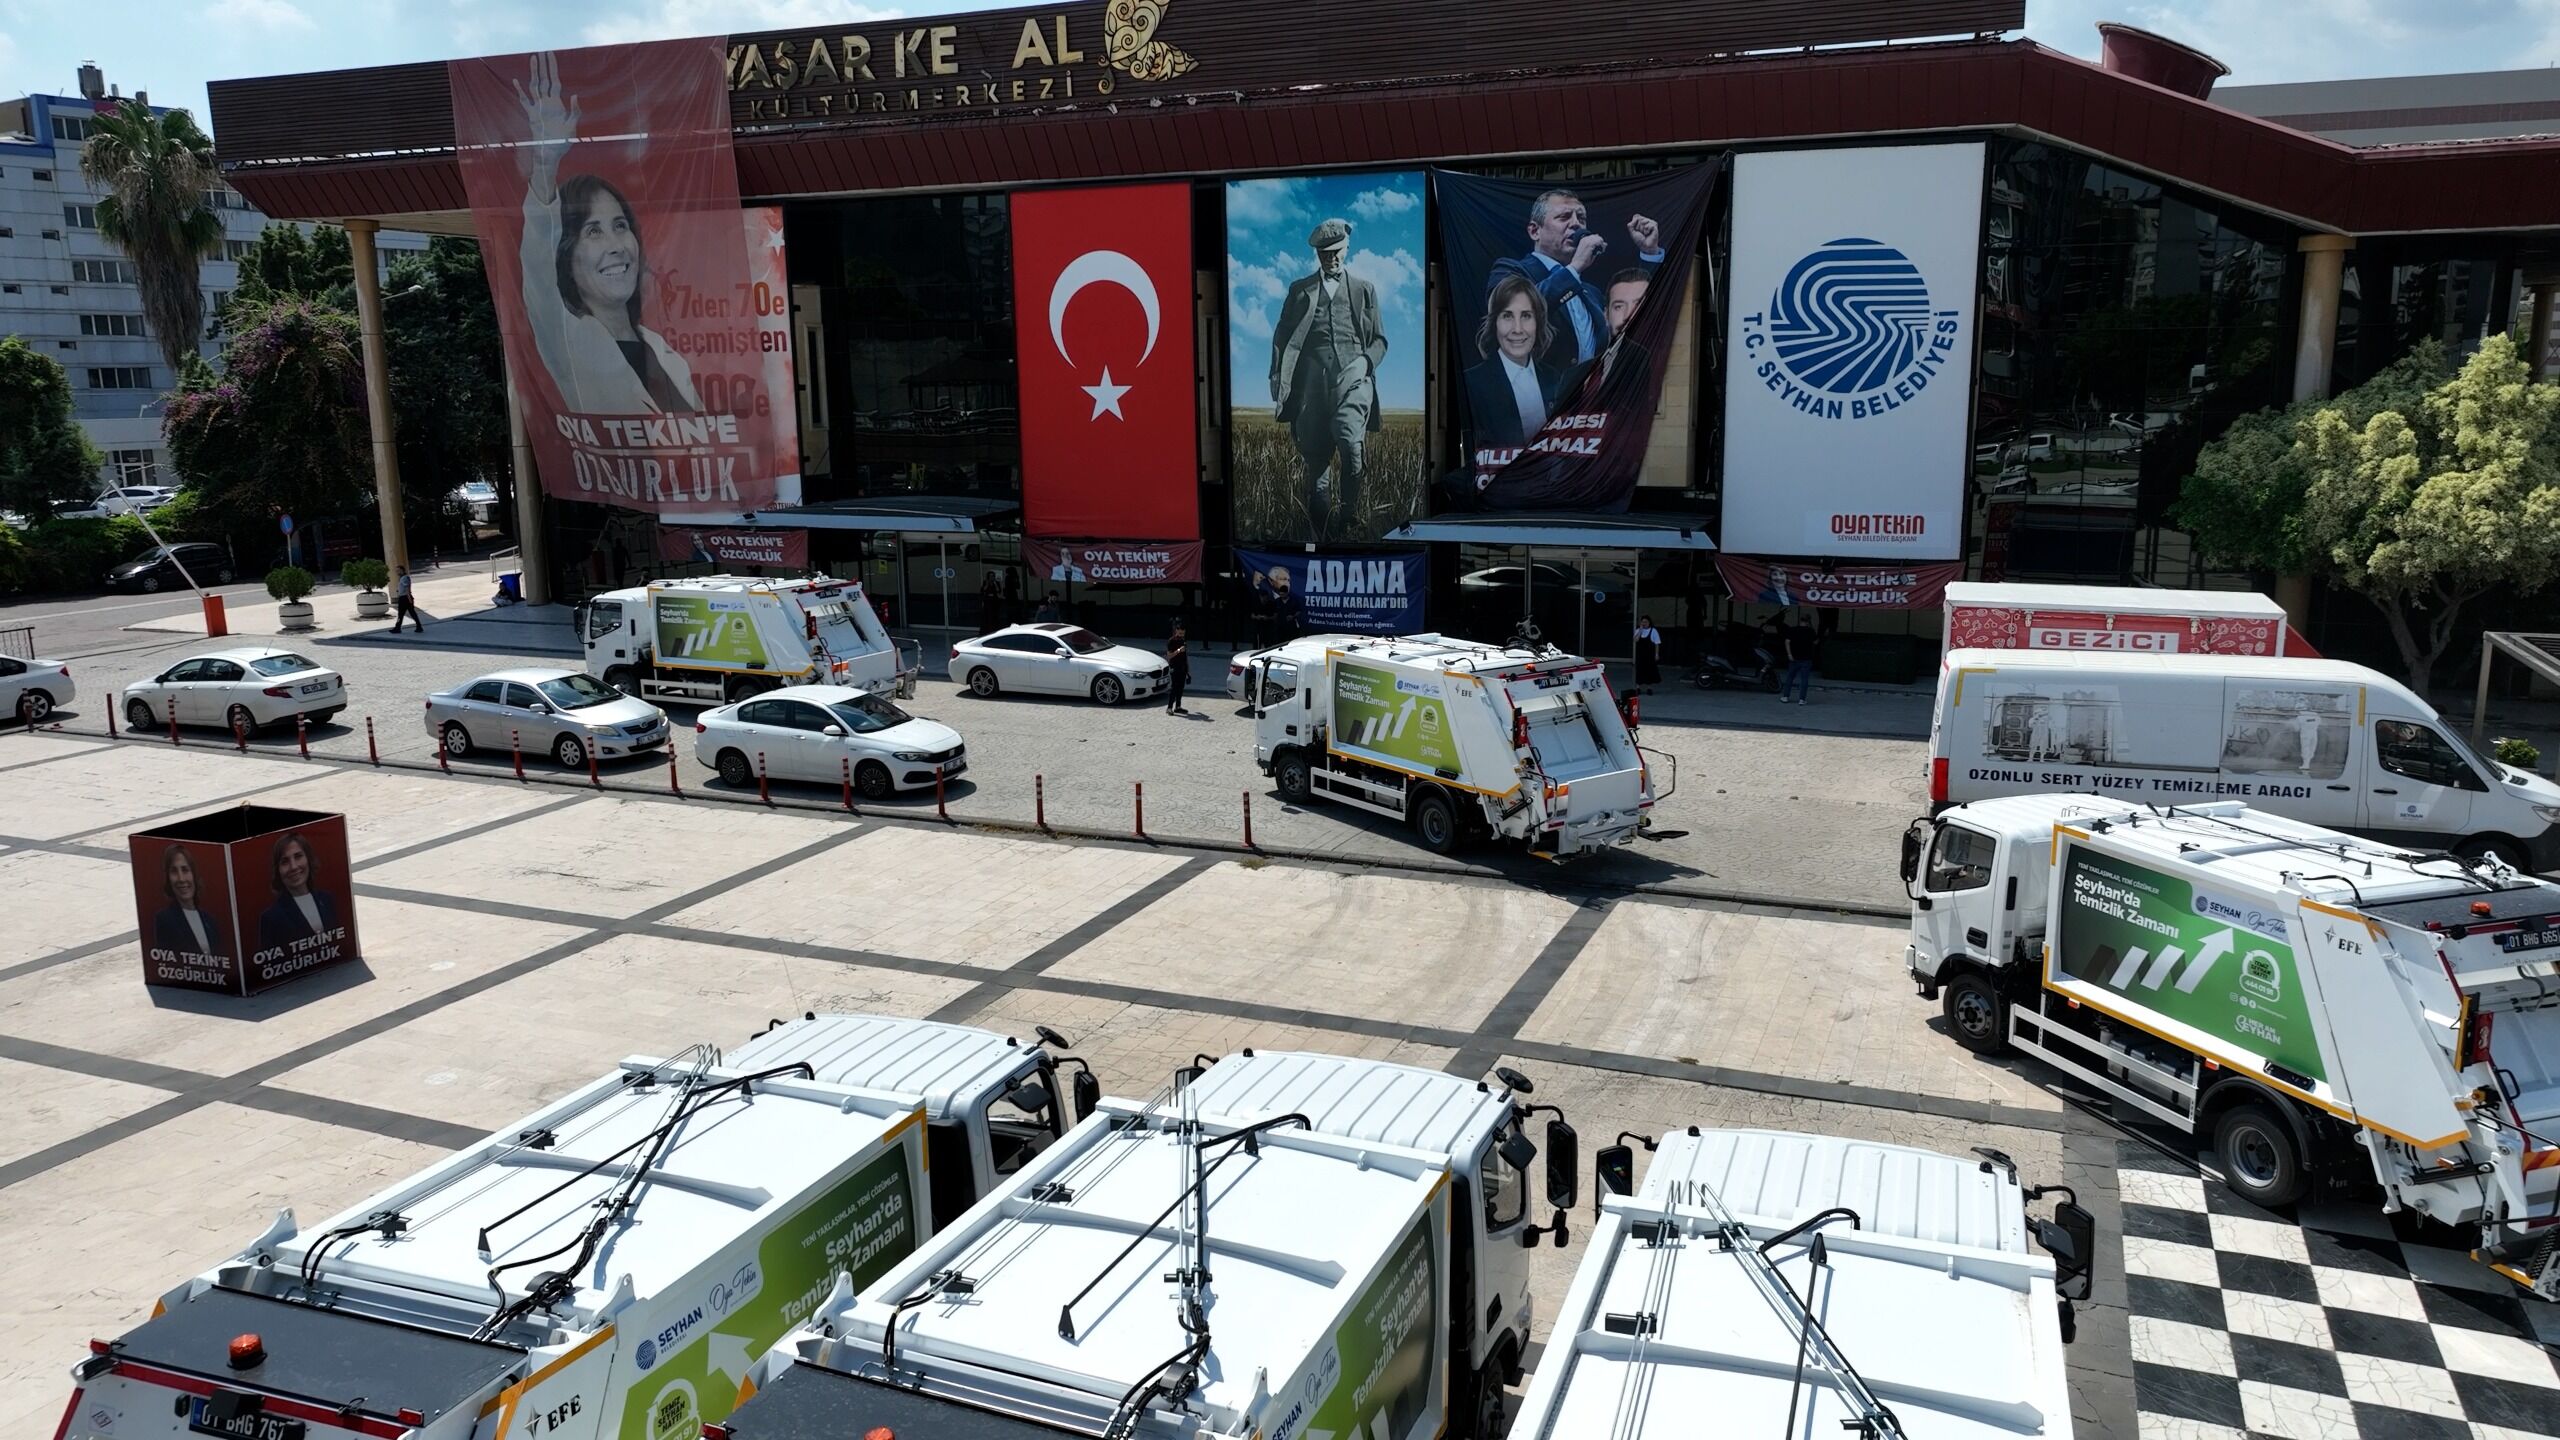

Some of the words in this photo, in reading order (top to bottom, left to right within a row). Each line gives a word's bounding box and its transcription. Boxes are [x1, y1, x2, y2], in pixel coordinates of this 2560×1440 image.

[1757, 360, 1843, 419] SEYHAN
[1851, 310, 1959, 419] BELEDİYESİ
[556, 413, 600, 446] OYA
[1543, 413, 1607, 431] ADESİ
[1528, 436, 1602, 455] AMAZ
[571, 441, 740, 502] ÖZGÜRLÜK
[710, 535, 736, 546] OYA
[719, 547, 783, 562] ÖZGÜRLÜK
[1084, 550, 1114, 561] OYA
[1091, 563, 1167, 579] ÖZGÜRLÜK
[1305, 559, 1407, 594] ADANA
[1800, 572, 1839, 584] OYA
[1843, 570, 1917, 586] TEKİNE
[1305, 595, 1340, 608] ZEYDAN
[1806, 586, 1909, 604] ÖZGÜRLÜK
[1338, 688, 1364, 701] Temizlik
[1969, 768, 2033, 783] OZONLU
[2041, 772, 2083, 787] SERT
[2092, 773, 2145, 790] YÜZEY
[2258, 785, 2312, 798] ARACI
[2074, 873, 2141, 908] Seyhan'da
[2073, 888, 2125, 920] Temizlik
[2126, 908, 2179, 939] Zamanı
[2210, 901, 2241, 919] SEYHAN
[150, 949, 177, 963] OYA
[253, 948, 285, 966] OYA
[2338, 937, 2363, 956] EFE
[262, 944, 341, 981] ÖZGÜRLÜK
[157, 963, 227, 986] ÖZGÜRLÜK
[825, 1194, 902, 1264] Seyhan'da
[801, 1236, 817, 1249] YENİ
[851, 1217, 905, 1272] Zamanı
[1380, 1258, 1429, 1342] Seyhan'da
[657, 1306, 703, 1348] SEYHAN
[1352, 1337, 1396, 1413] Temizlik
[1395, 1285, 1430, 1348] Zamanı
[546, 1394, 582, 1433] EFE
